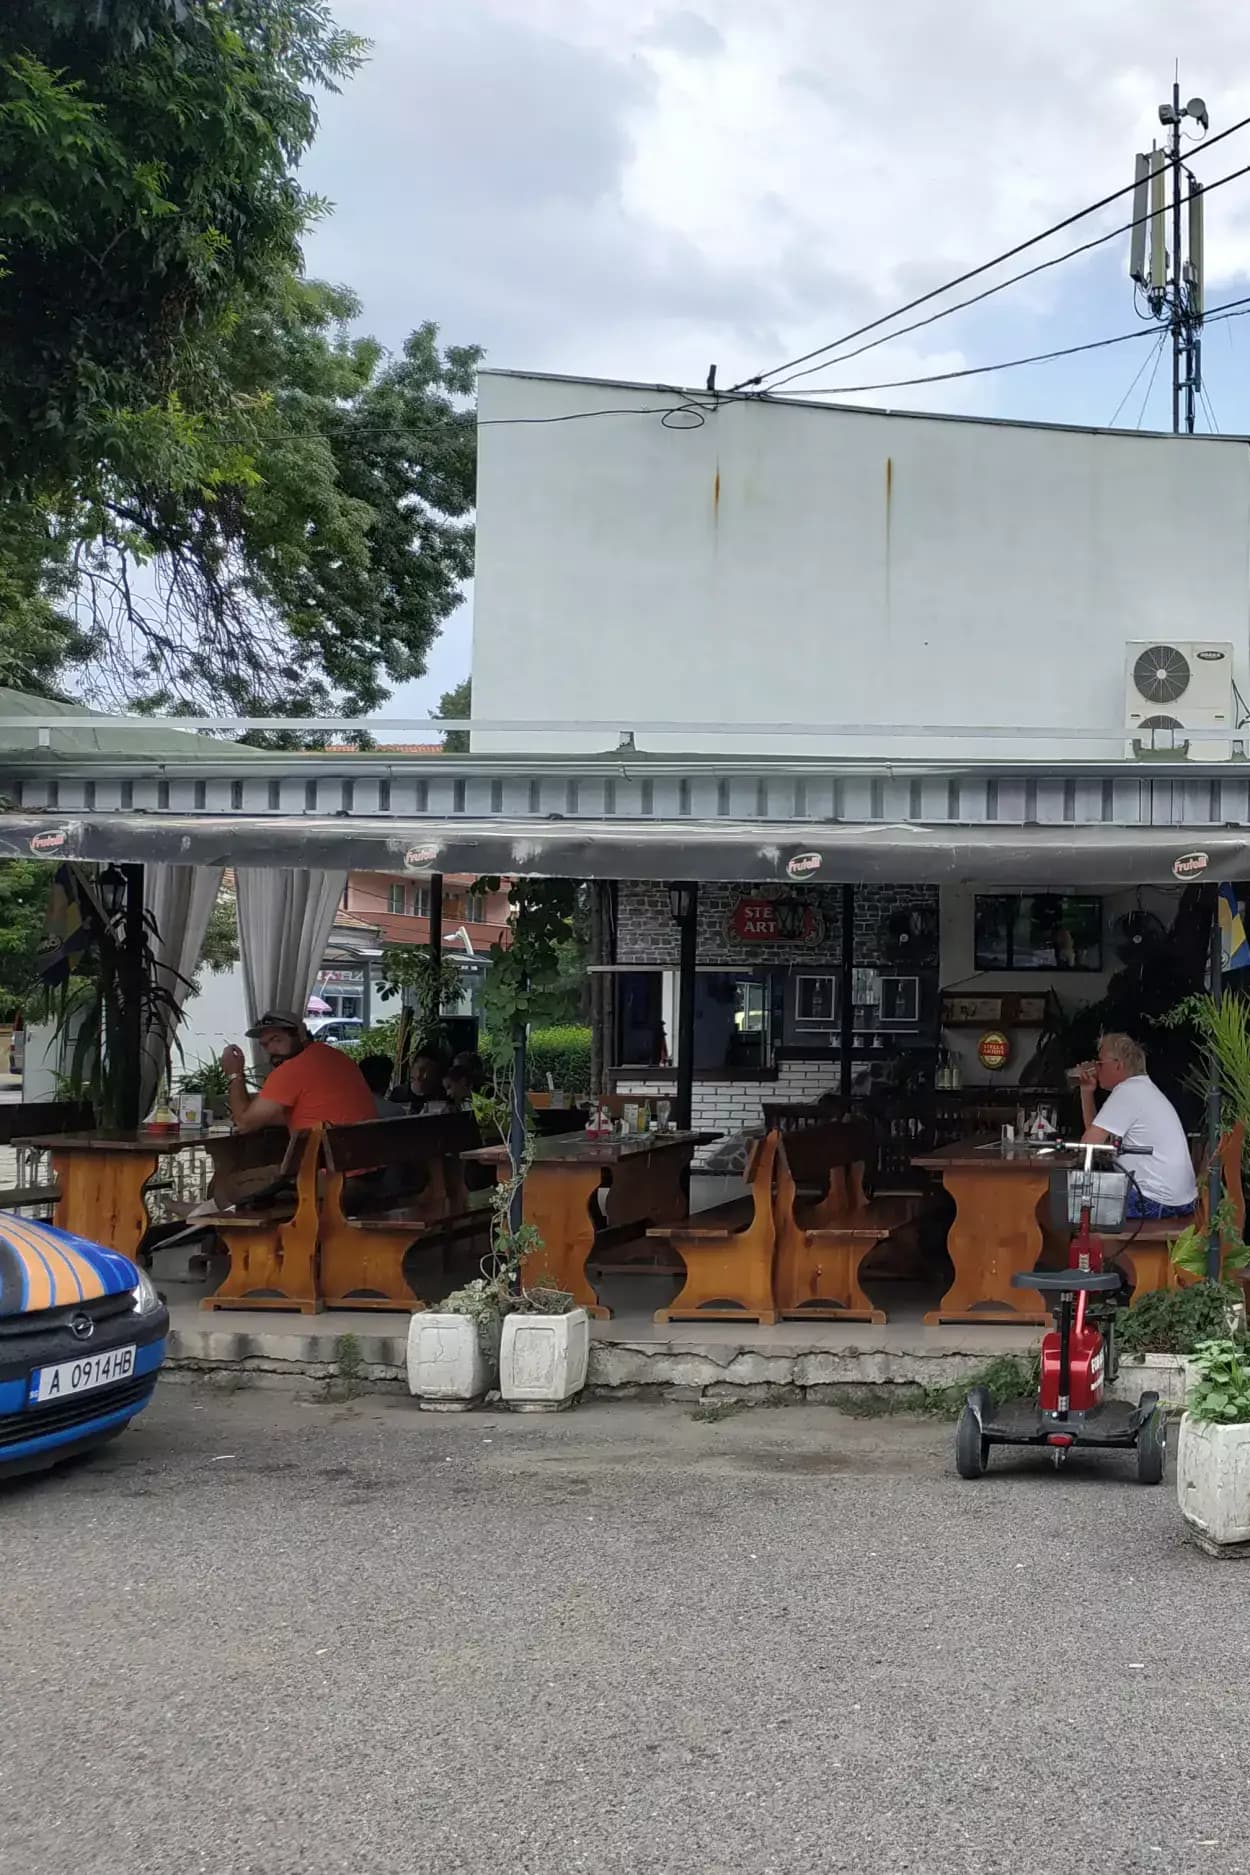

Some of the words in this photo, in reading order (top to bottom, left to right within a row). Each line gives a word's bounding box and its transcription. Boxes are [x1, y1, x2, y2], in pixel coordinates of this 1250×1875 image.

[744, 906, 774, 918] STE
[744, 921, 776, 933] ART
[48, 1368, 60, 1395] A
